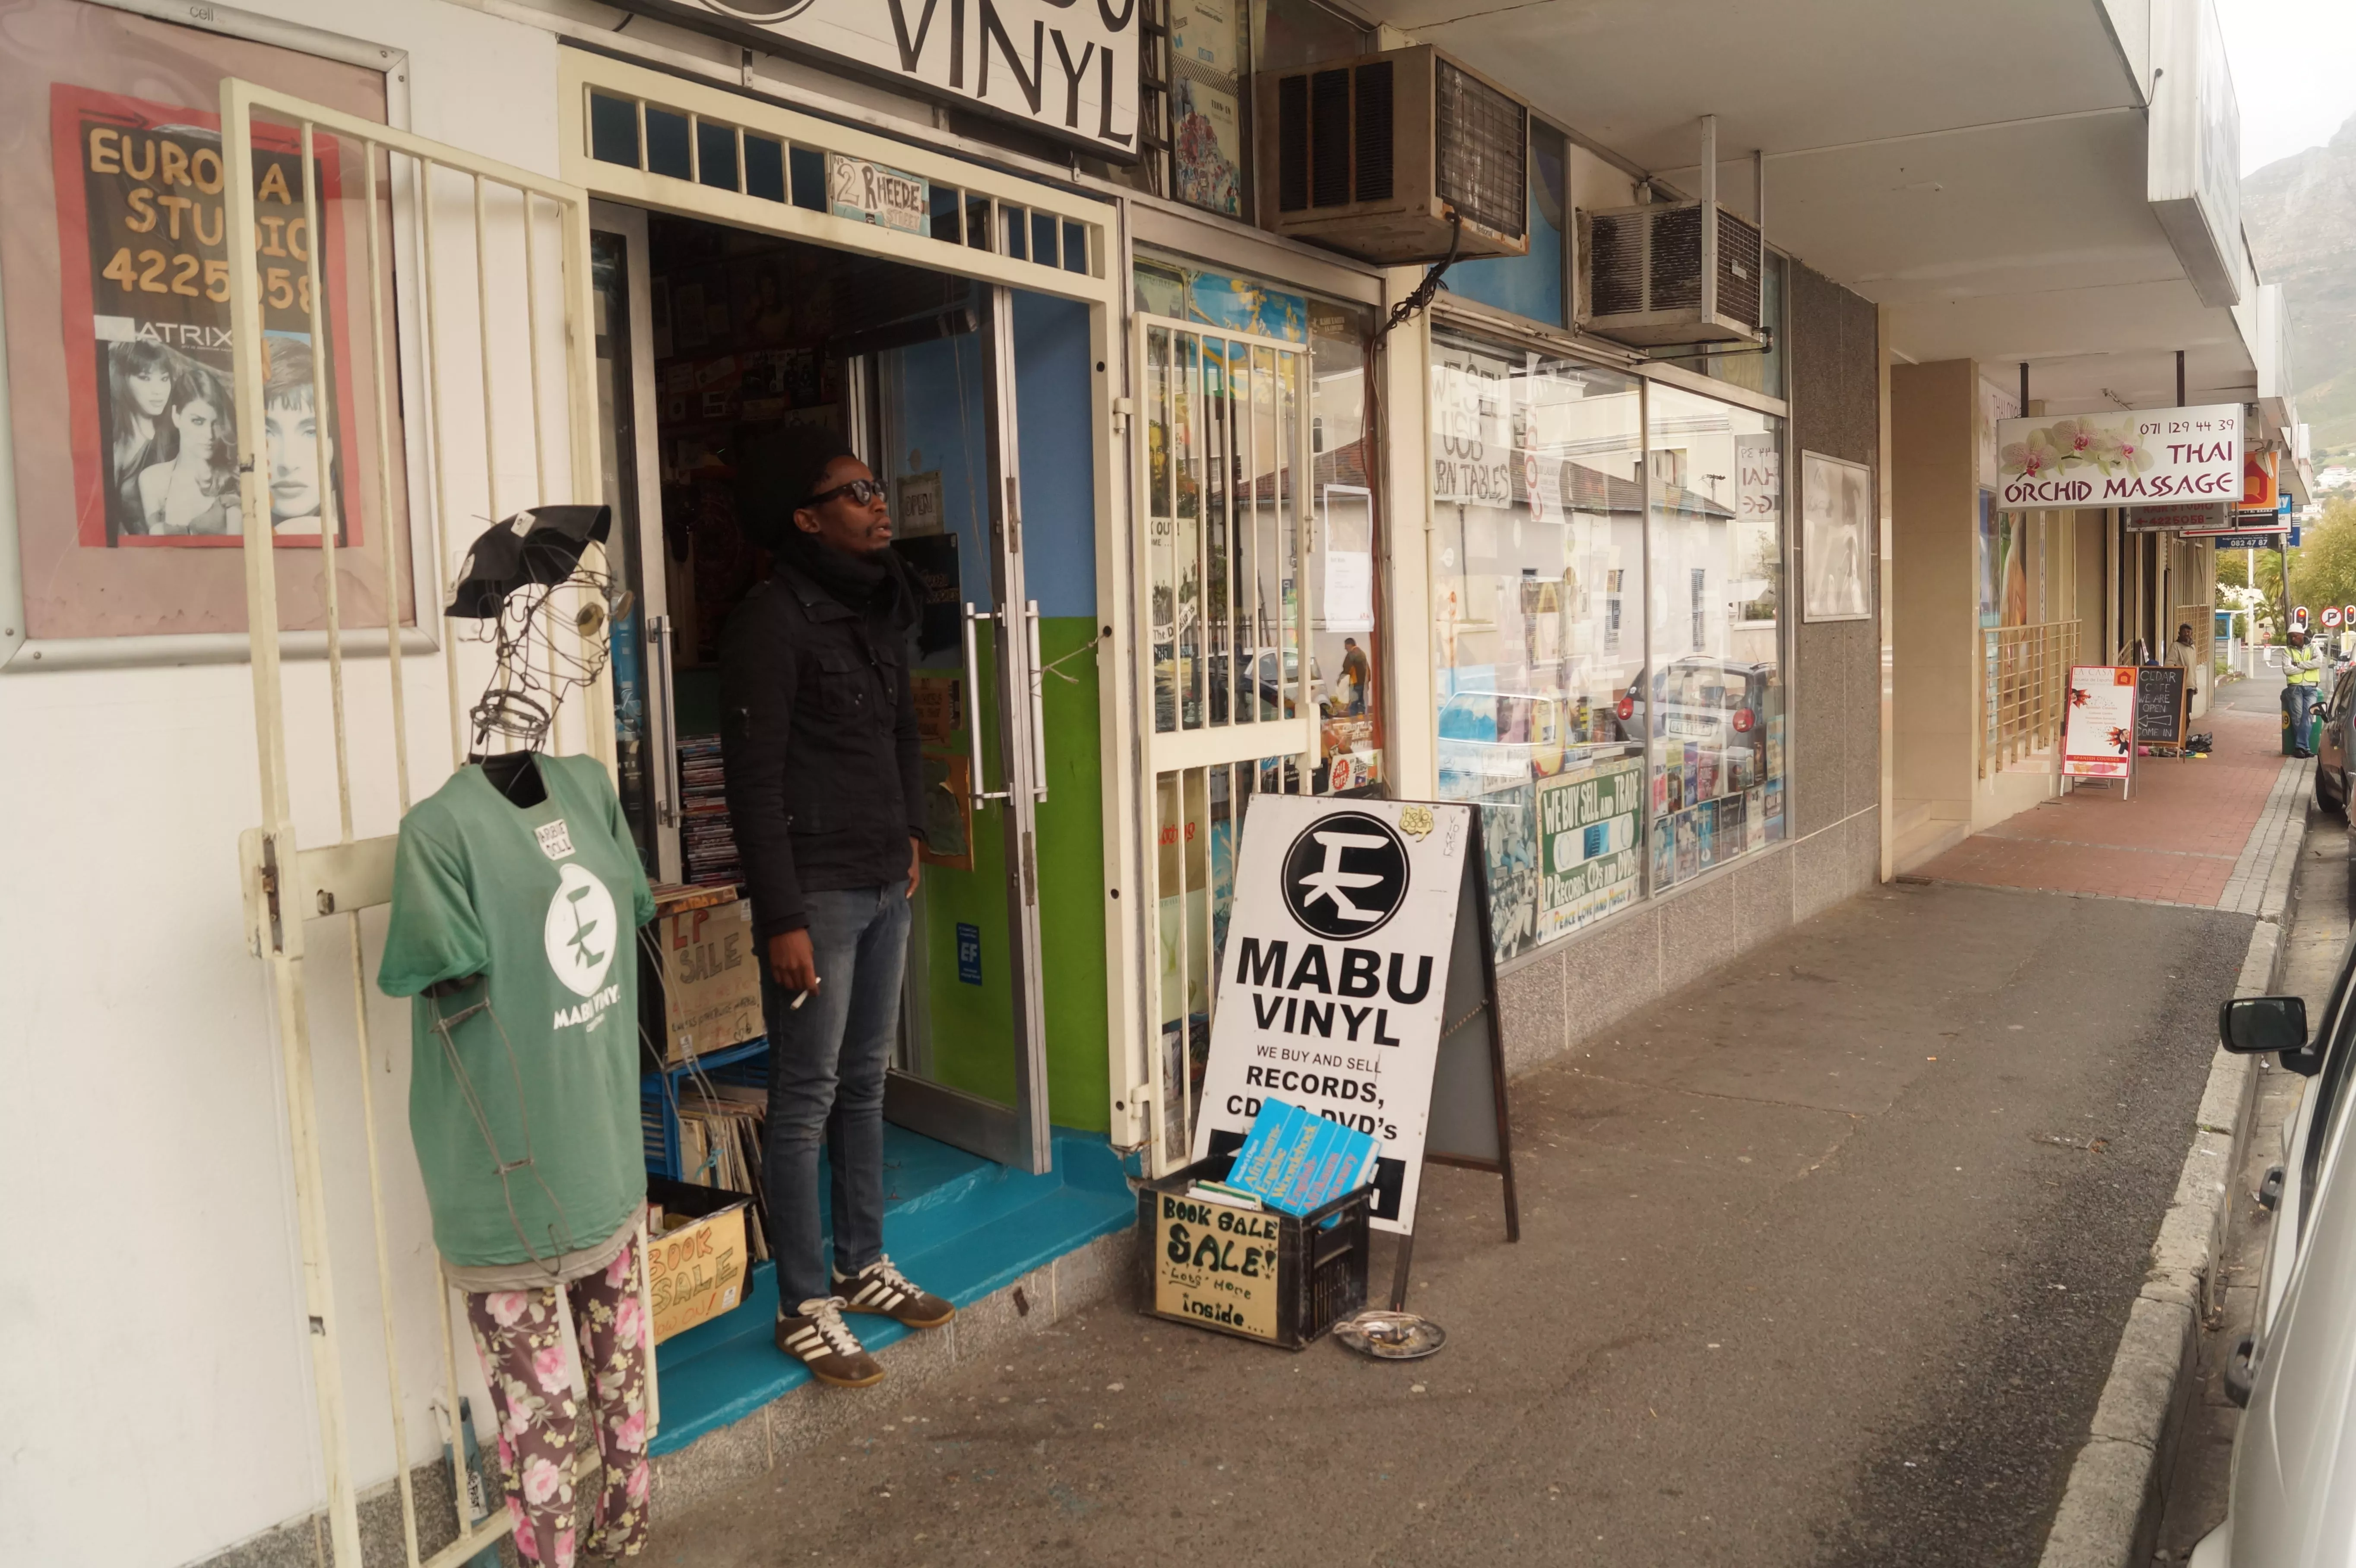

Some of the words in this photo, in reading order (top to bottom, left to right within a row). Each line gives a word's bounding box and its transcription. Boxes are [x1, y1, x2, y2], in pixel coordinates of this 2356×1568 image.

[190, 6, 213, 22] cell
[888, 0, 1133, 147] VINYL
[89, 127, 291, 205] EUROA
[836, 163, 860, 206] 2
[861, 166, 920, 212] RHEEDE
[125, 187, 310, 262] STUIO
[886, 208, 920, 231] STREET
[102, 247, 321, 314] 422558
[1441, 411, 1483, 461] USB
[2140, 423, 2160, 435] 071
[2169, 422, 2189, 434] 129
[2196, 421, 2211, 432] 44
[2218, 419, 2234, 430] 39
[2166, 441, 2232, 465] THAI
[1434, 459, 1457, 496] URN
[1460, 464, 1508, 503] TABLES
[2004, 480, 2092, 503] ORCHID
[2103, 472, 2233, 499] MASSAGE
[905, 493, 932, 516] OPEN
[2328, 612, 2337, 623] P
[2140, 670, 2176, 683] CEDAR
[2145, 683, 2170, 692] CFE
[2142, 704, 2166, 712] OPEN
[2153, 694, 2170, 703] ARE
[2163, 728, 2172, 737] IN
[1543, 790, 1561, 835] WE
[1580, 781, 1599, 824] SELL
[1600, 796, 1614, 819] AND
[1614, 771, 1639, 815] TRADE
[1543, 876, 1554, 911] LP
[1604, 863, 1617, 886] AND
[672, 909, 709, 951] LP
[680, 932, 742, 984] SALE
[961, 942, 978, 963] EF
[1236, 937, 1434, 1005] MABU
[593, 983, 621, 1013] VINY
[1252, 993, 1400, 1047] VINYL
[1257, 1045, 1277, 1059] WE
[1281, 1049, 1310, 1063] BUY
[1313, 1053, 1342, 1067] AND
[1347, 1058, 1382, 1074] SELL
[1246, 1065, 1384, 1110] RECORDS,
[1164, 1196, 1213, 1227] BOOK
[1217, 1211, 1278, 1241] SALE
[649, 1227, 714, 1282] BOOK
[651, 1246, 738, 1317] SALE
